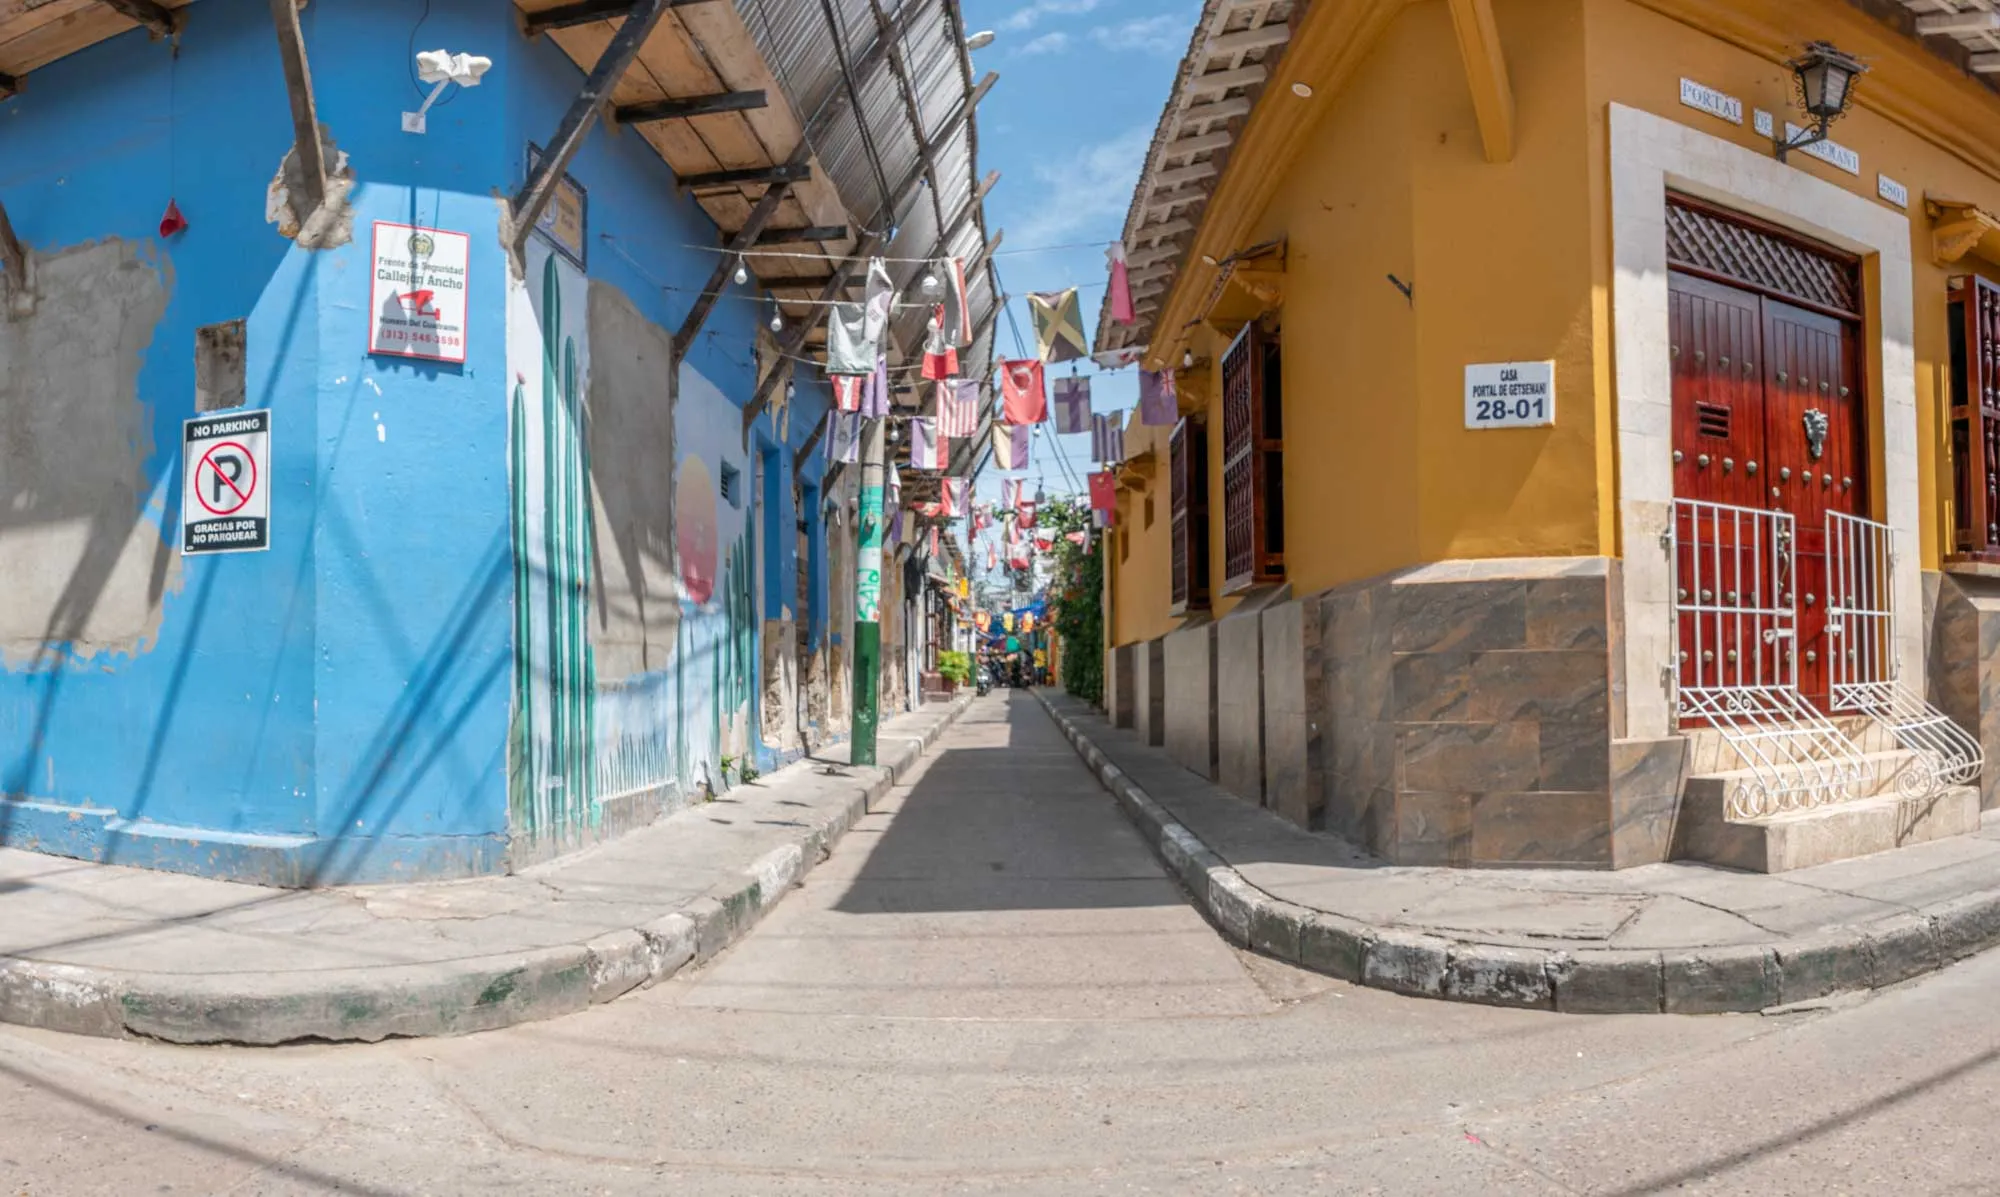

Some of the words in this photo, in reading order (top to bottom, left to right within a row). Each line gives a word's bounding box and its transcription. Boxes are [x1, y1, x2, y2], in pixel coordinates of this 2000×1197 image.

[1755, 111, 1771, 132] DE
[378, 256, 405, 267] Frente
[422, 261, 464, 275] Seguridad
[427, 275, 463, 290] Ancho
[1500, 369, 1518, 382] CASA
[1472, 384, 1497, 398] PORTAL
[1498, 383, 1507, 396] DE
[1508, 382, 1547, 396] GETSEMANI
[1476, 398, 1544, 421] 28-01
[193, 426, 211, 438] NO
[212, 418, 260, 435] PARKING
[194, 521, 234, 534] GRACIAS
[235, 519, 256, 531] POR
[192, 533, 207, 544] NO
[207, 530, 258, 543] PARQUEAR
